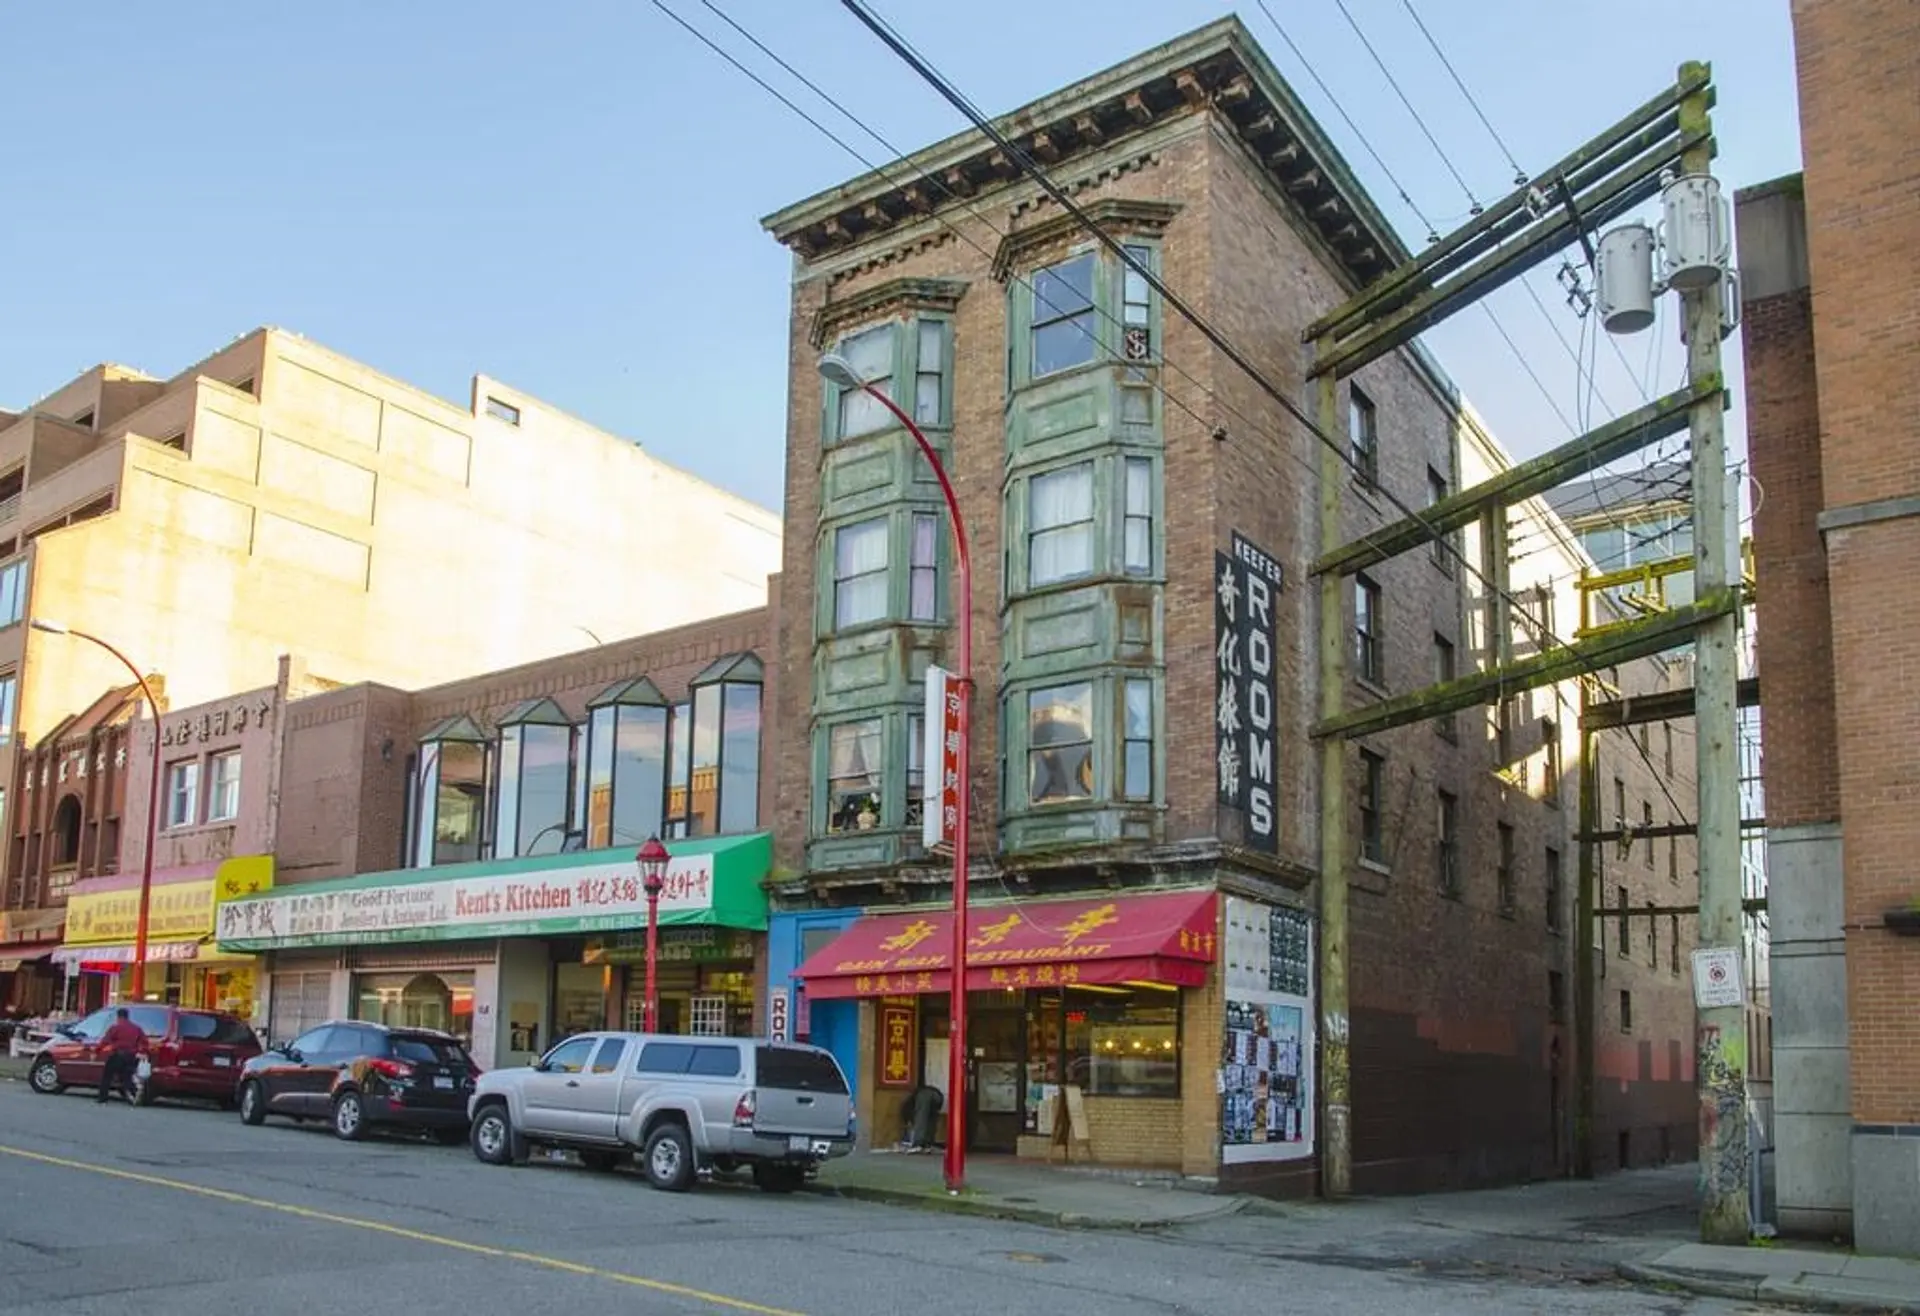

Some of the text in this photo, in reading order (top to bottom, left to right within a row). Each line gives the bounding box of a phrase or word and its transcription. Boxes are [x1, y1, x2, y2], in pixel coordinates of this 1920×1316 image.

[1235, 537, 1281, 584] KEEFER
[1247, 571, 1273, 836] ROOMS
[353, 890, 383, 908] Good
[387, 886, 434, 904] Fortune
[455, 881, 571, 916] Kent's Kitchen
[966, 944, 1111, 963] ESTAURANT
